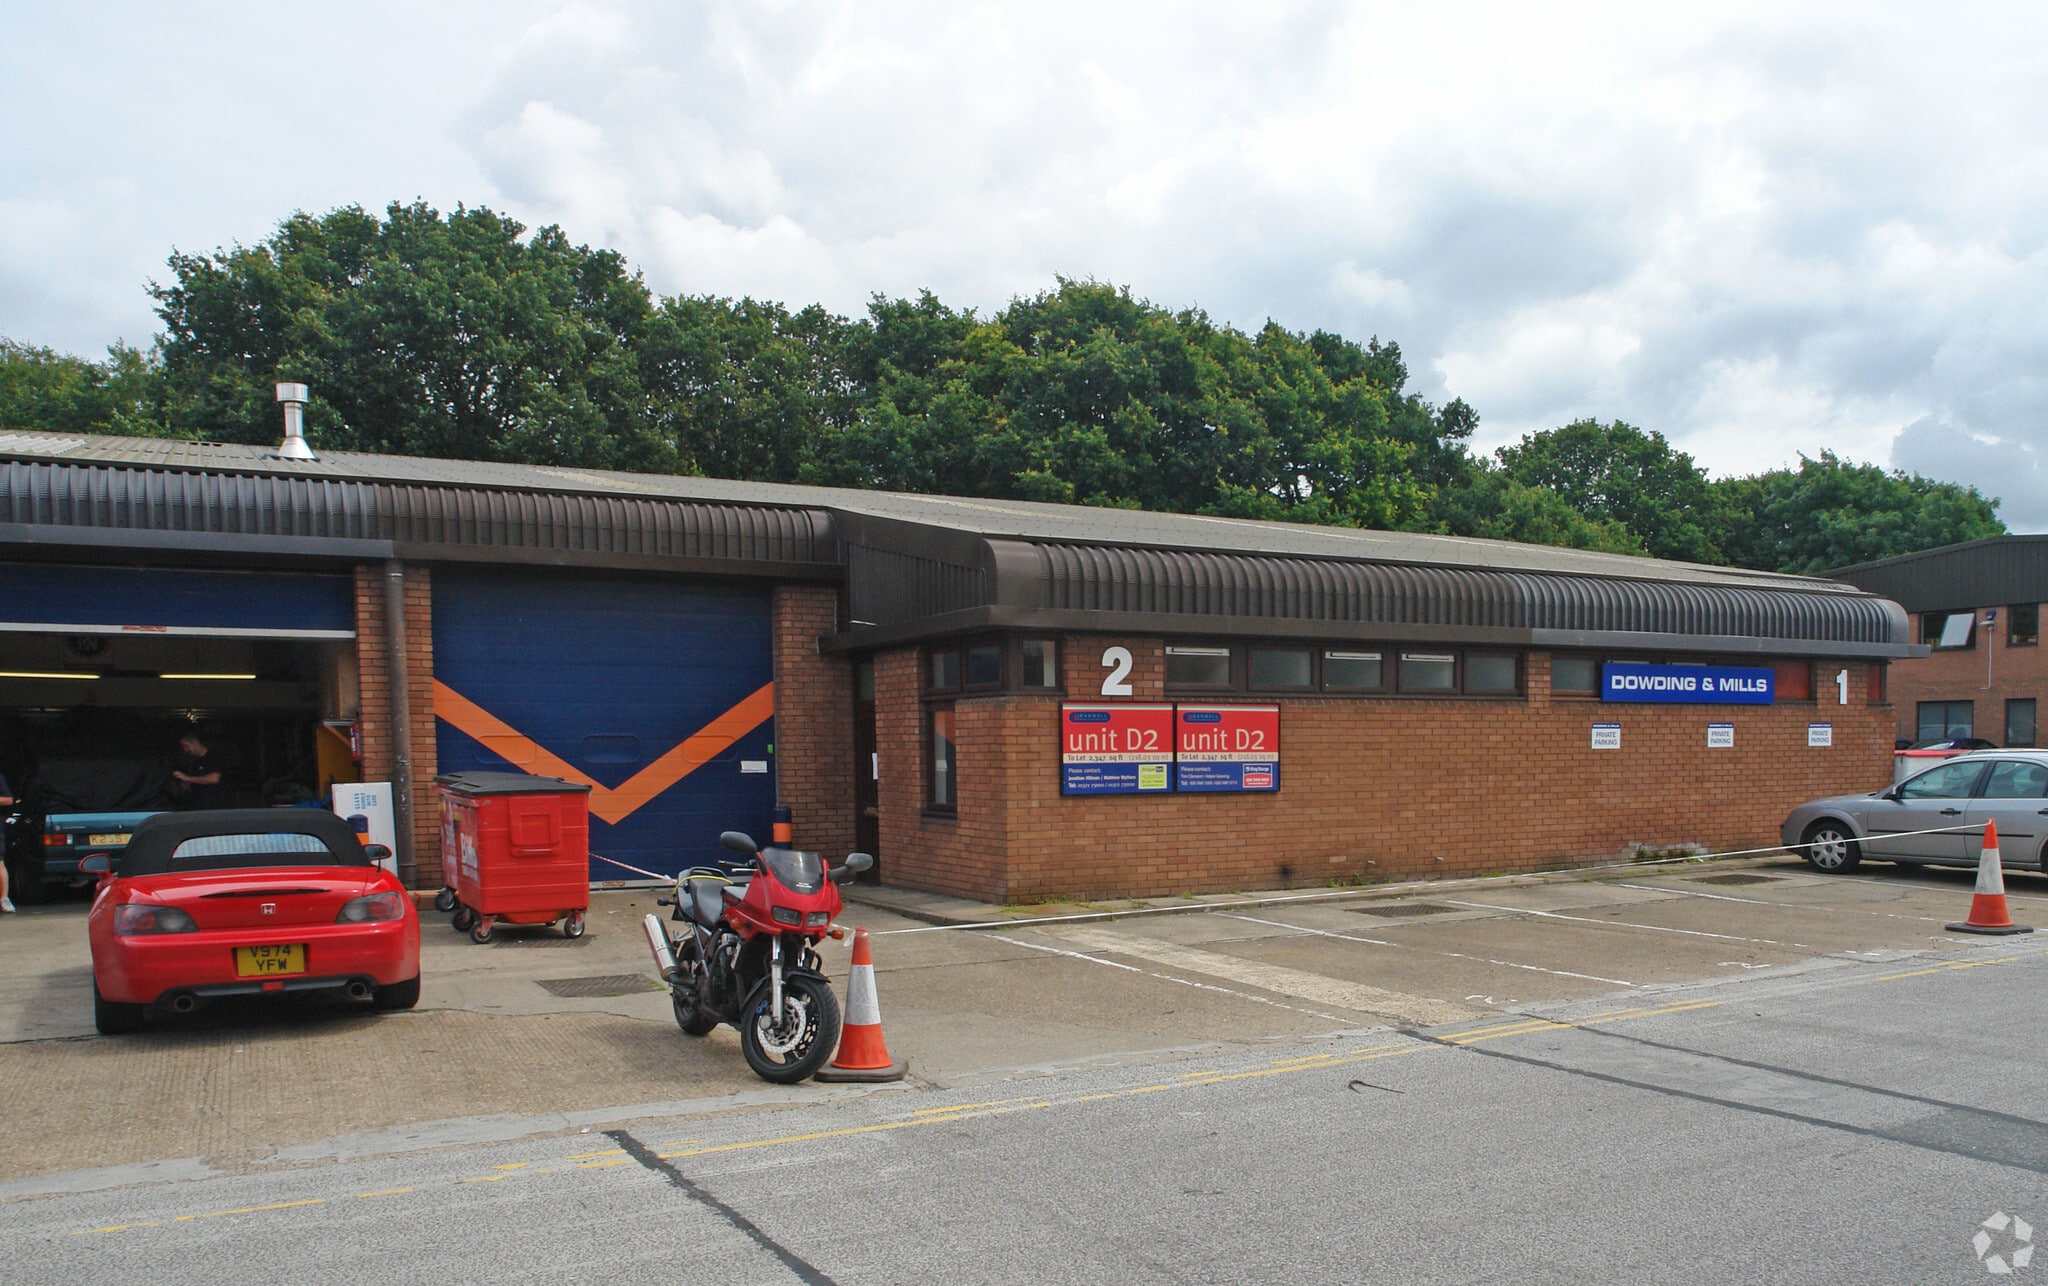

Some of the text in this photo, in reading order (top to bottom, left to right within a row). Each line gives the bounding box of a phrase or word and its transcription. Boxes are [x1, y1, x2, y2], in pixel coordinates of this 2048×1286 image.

[1101, 646, 1133, 696] 2
[1611, 675, 1768, 692] DOWDING & MILLS
[1836, 669, 1848, 705] 1
[1069, 727, 1159, 751] unit D2
[1183, 727, 1265, 750] unit D2
[250, 944, 291, 958] V974
[256, 958, 287, 971] YFW
